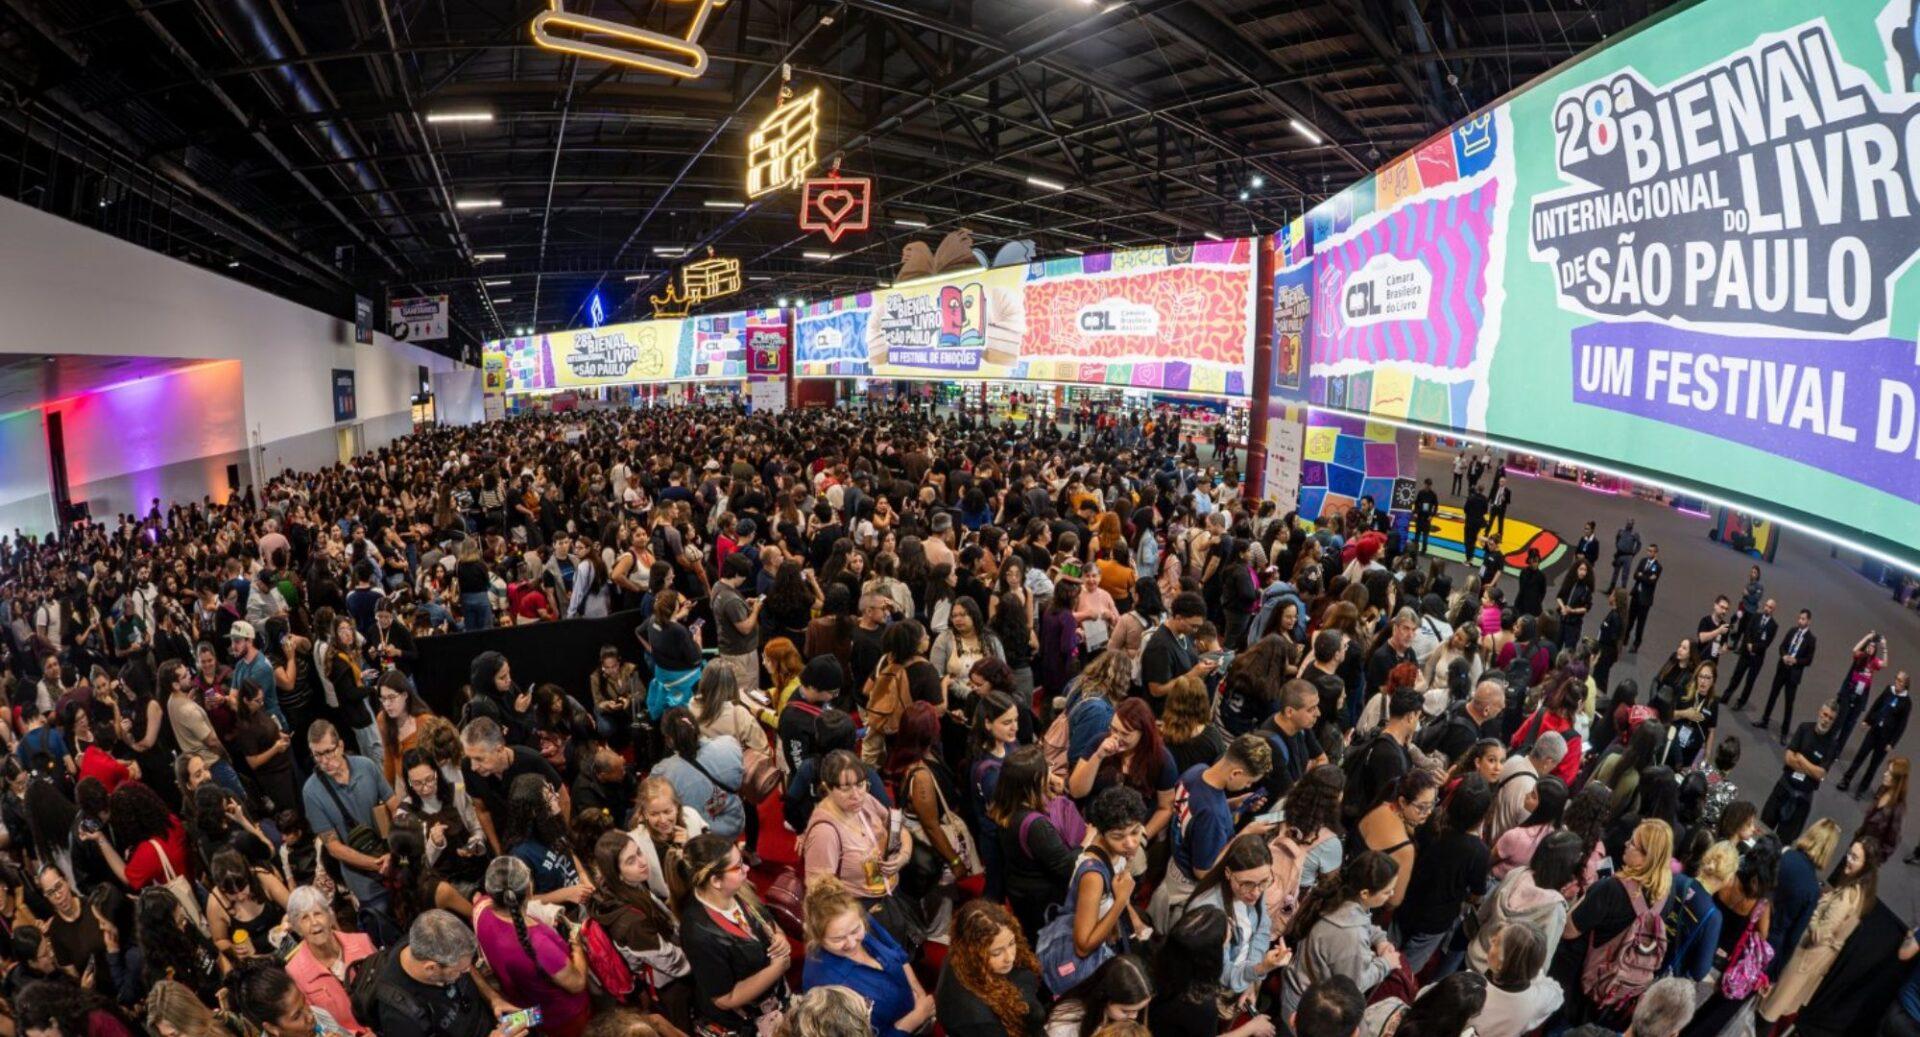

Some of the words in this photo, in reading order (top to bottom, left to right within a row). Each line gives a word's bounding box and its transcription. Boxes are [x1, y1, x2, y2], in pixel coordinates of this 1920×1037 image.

[1620, 33, 1867, 184] BIENAL
[1535, 170, 1729, 242] INTERNACIONAL
[1723, 210, 1748, 233] DO
[1561, 255, 1588, 290] DE
[1586, 232, 1672, 306] SÃO
[1684, 236, 1872, 321] PAULO
[1386, 285, 1422, 300] Brasileira
[913, 311, 941, 330] LIVRO
[588, 335, 629, 353] BIENAL
[608, 346, 638, 363] LIVRO
[900, 351, 928, 364] FESTIVAL
[929, 352, 938, 363] DE
[579, 361, 596, 376] SÃO
[598, 362, 627, 375] PAULO
[1580, 345, 1634, 397] UM
[1645, 349, 1856, 443] FESTIVAL
[1875, 378, 1920, 462] D
